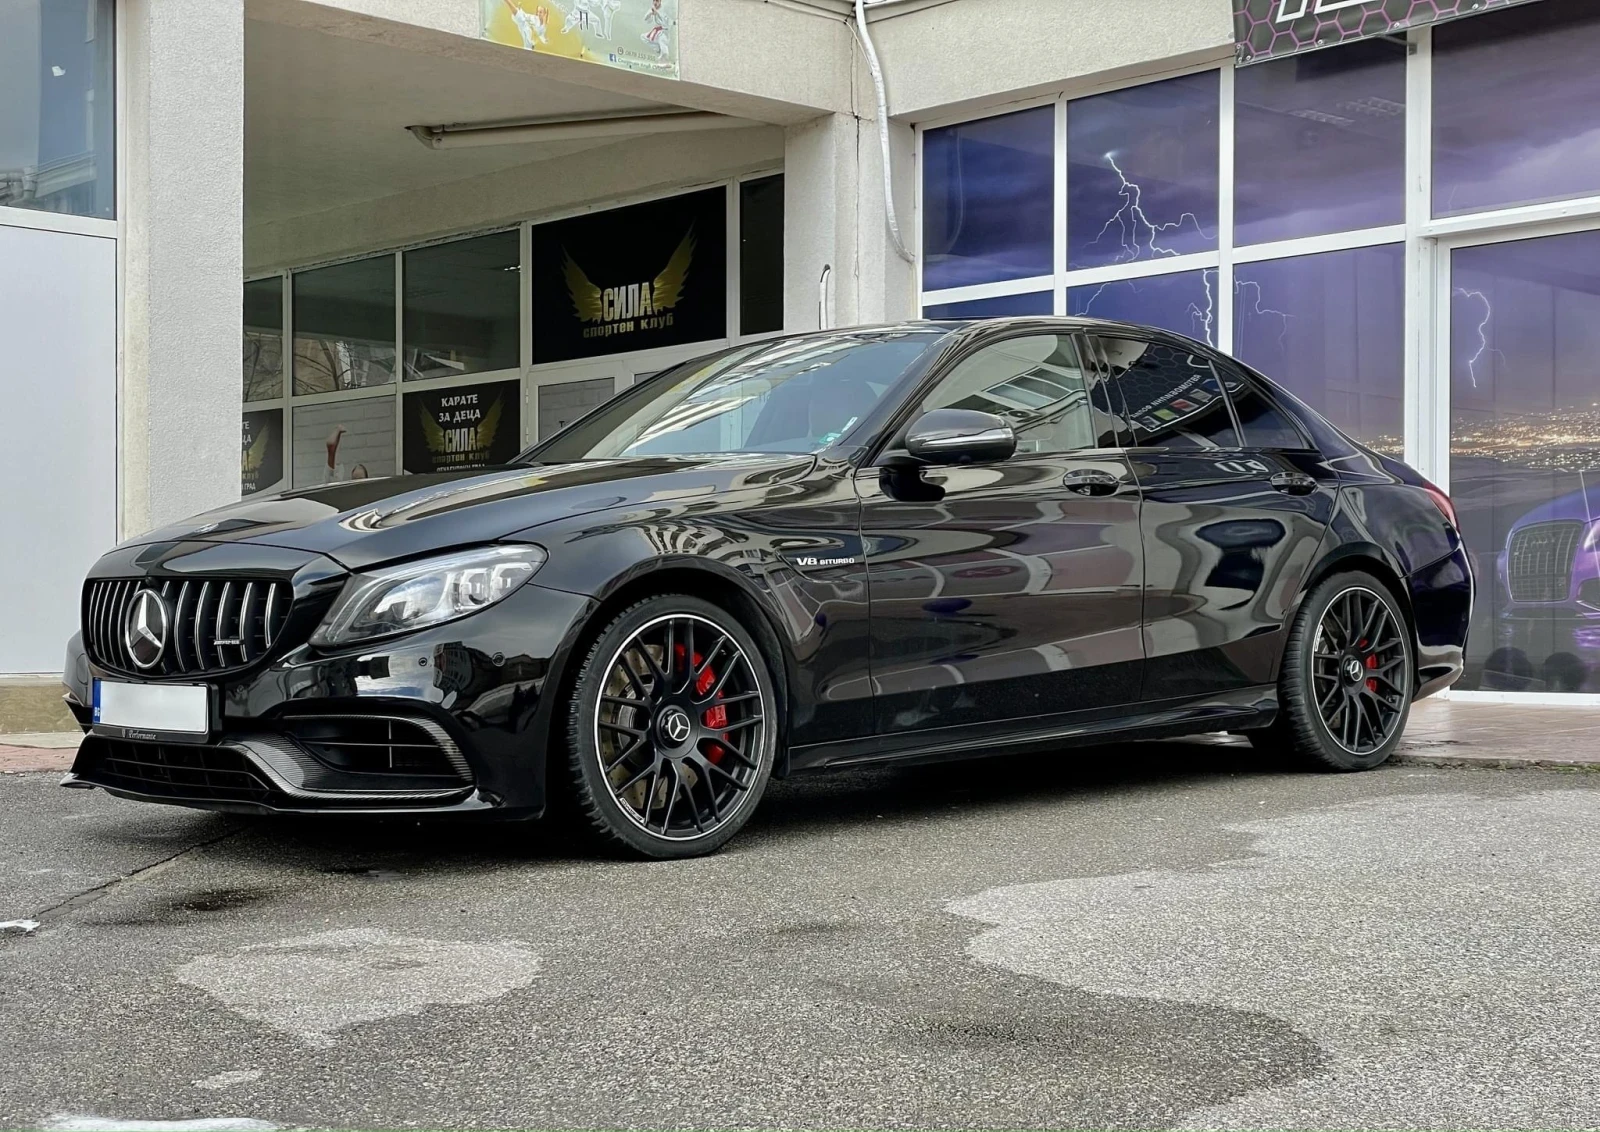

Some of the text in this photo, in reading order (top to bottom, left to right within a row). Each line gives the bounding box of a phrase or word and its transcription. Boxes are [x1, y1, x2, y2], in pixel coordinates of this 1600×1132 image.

[603, 282, 652, 322] СИЛА
[583, 313, 673, 338] спортен клуб
[441, 394, 478, 407] КАРАТЕ
[438, 409, 481, 424] ЗА ДЕЦА
[445, 427, 476, 453] СИЛА
[796, 557, 855, 566] V8 BITURBO
